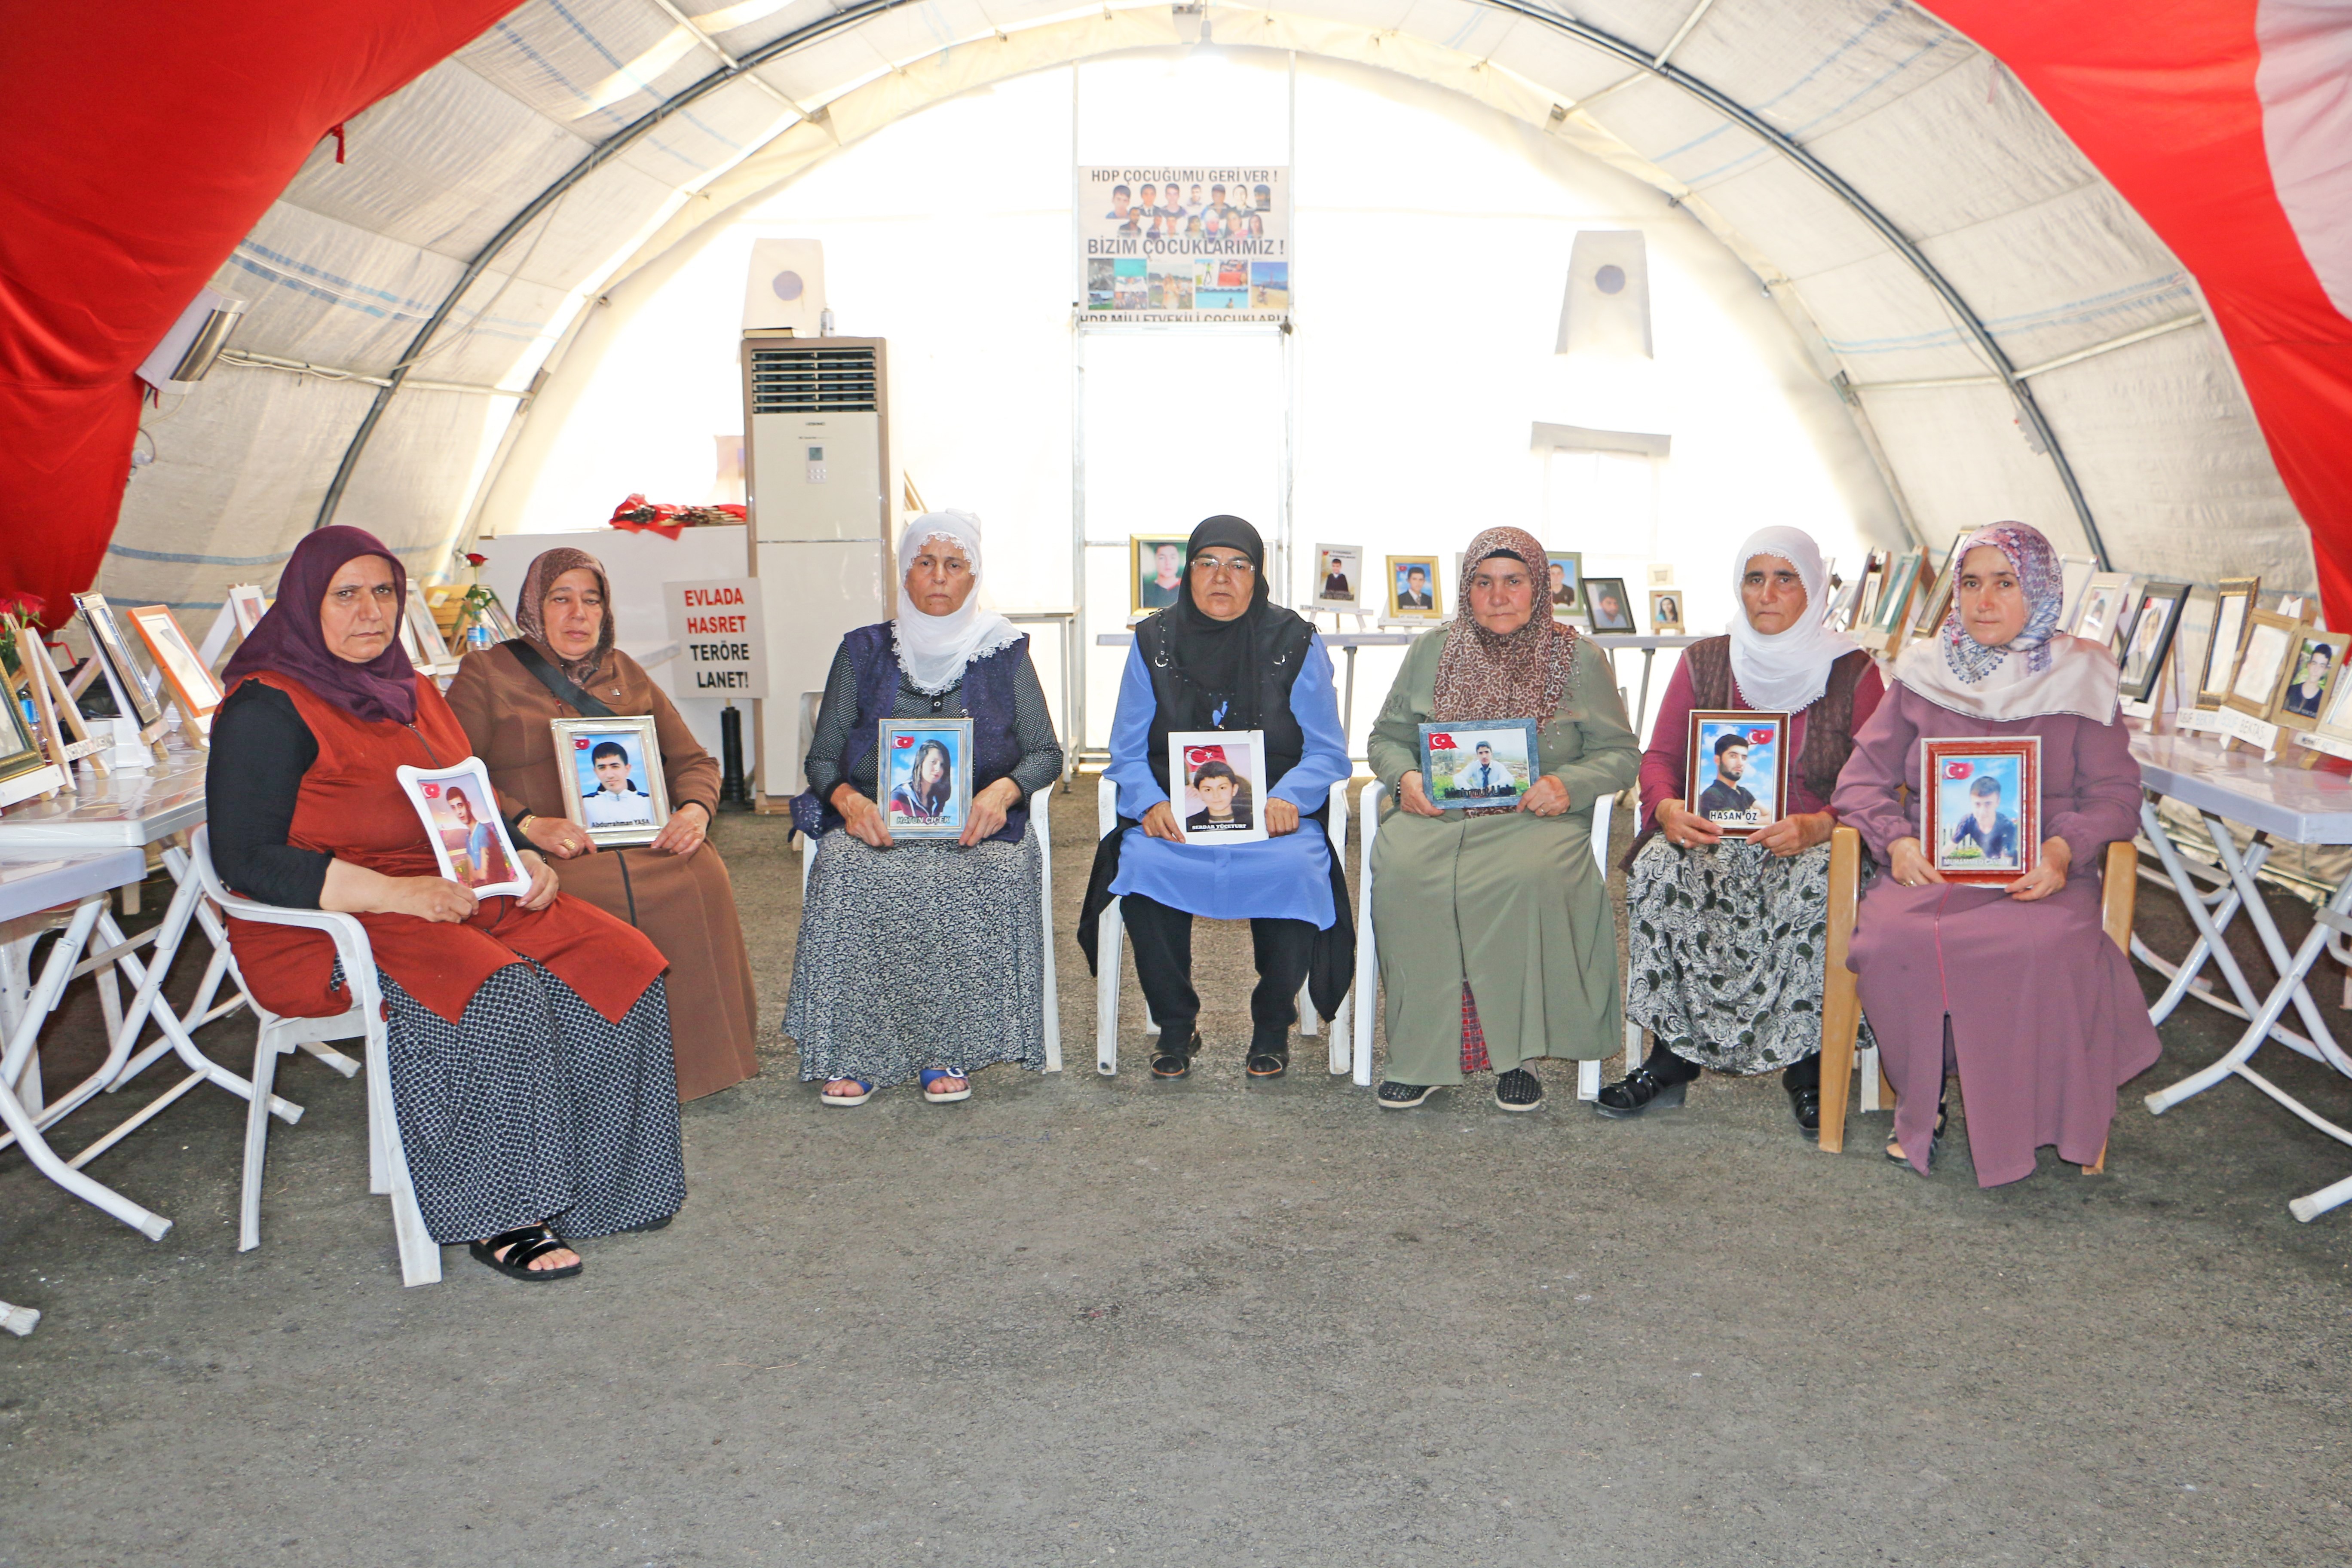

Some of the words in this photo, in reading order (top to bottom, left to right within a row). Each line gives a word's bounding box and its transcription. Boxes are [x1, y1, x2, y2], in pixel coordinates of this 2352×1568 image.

[1091, 170, 1119, 182] HDP
[1124, 167, 1204, 184] ÇOCUĞUMU
[1209, 167, 1240, 182] GERİ
[1243, 170, 1269, 182] VER
[1274, 170, 1278, 182] !
[1088, 236, 1136, 254] BİZİM
[1143, 239, 1274, 260] ÇOCUKLARIMIZ
[1280, 239, 1284, 254] !
[684, 588, 744, 606] EVLADA
[687, 616, 746, 634] HASRET
[690, 640, 750, 661] TERÖRE
[697, 672, 748, 688] LANET!
[1444, 787, 1491, 799] Mahmut
[1710, 812, 1742, 821] HASAN
[1745, 810, 1757, 821] ÖZ
